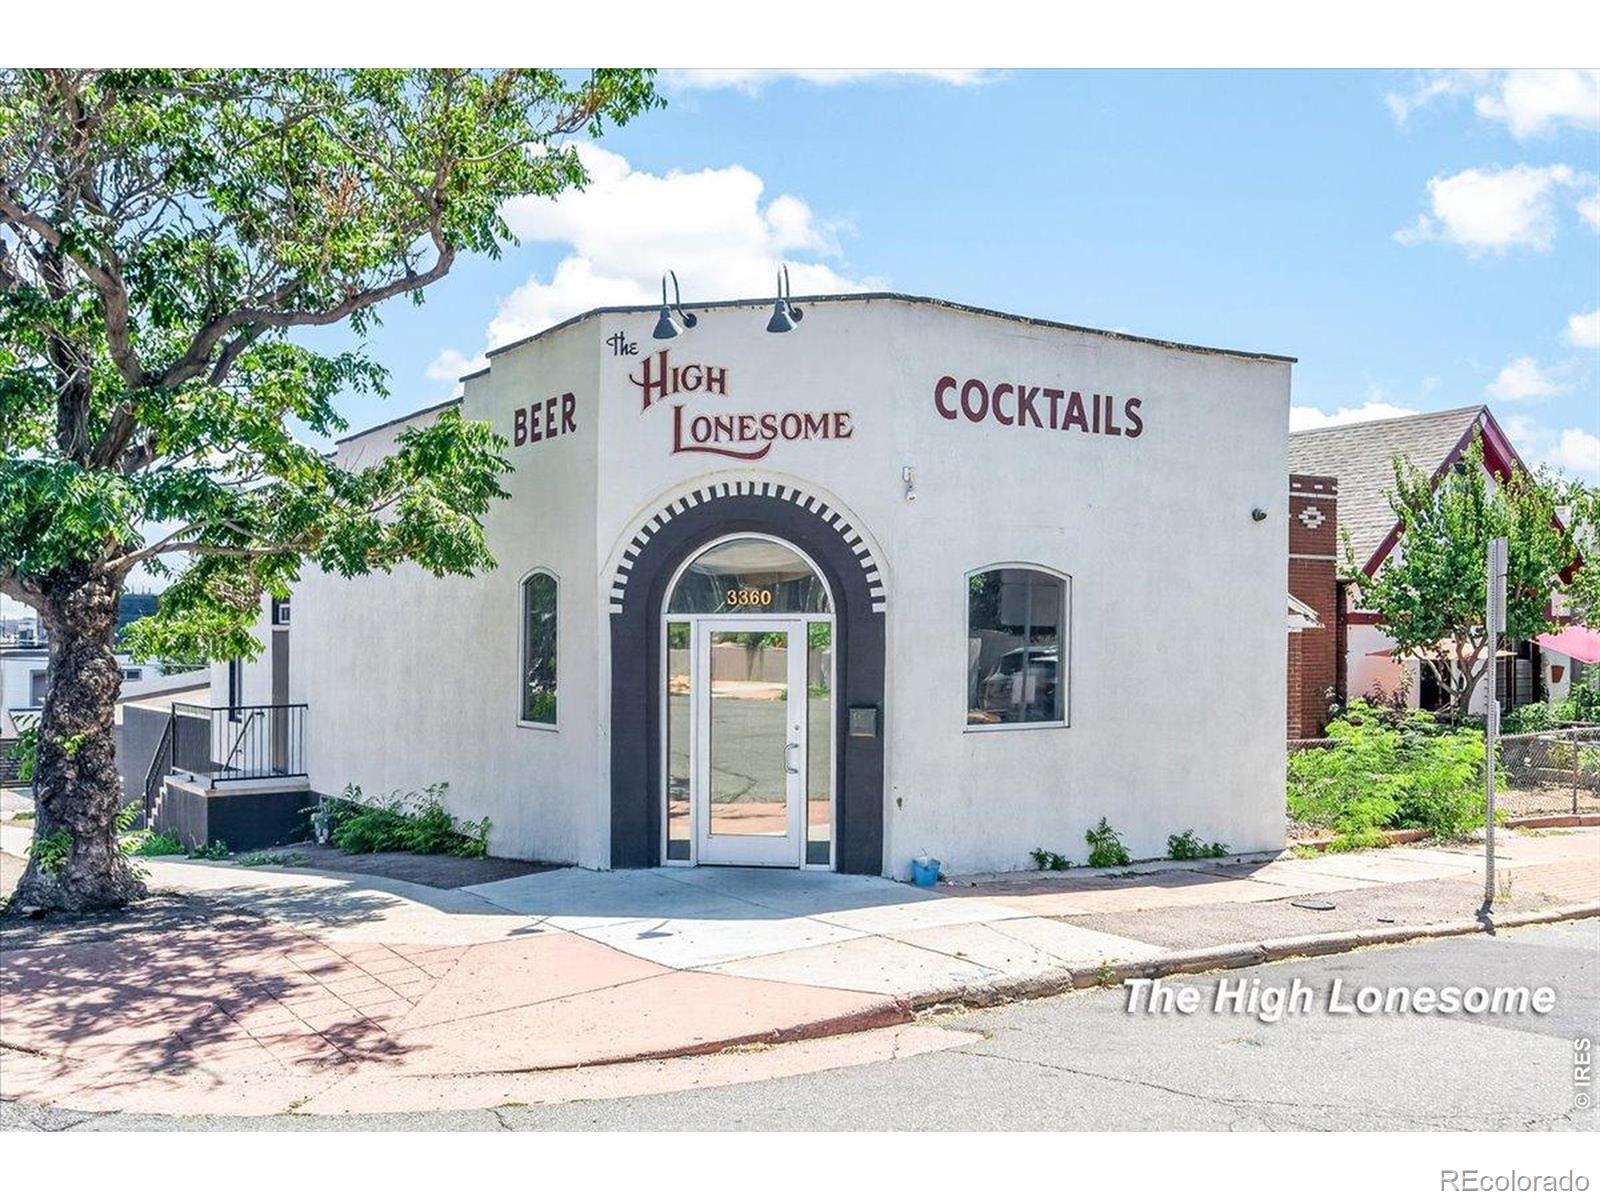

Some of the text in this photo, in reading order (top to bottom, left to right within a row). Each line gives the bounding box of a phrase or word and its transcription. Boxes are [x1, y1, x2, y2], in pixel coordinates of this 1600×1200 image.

[514, 391, 577, 448] BEER
[934, 375, 1143, 438] COCKTAILS
[727, 590, 772, 607] 3360
